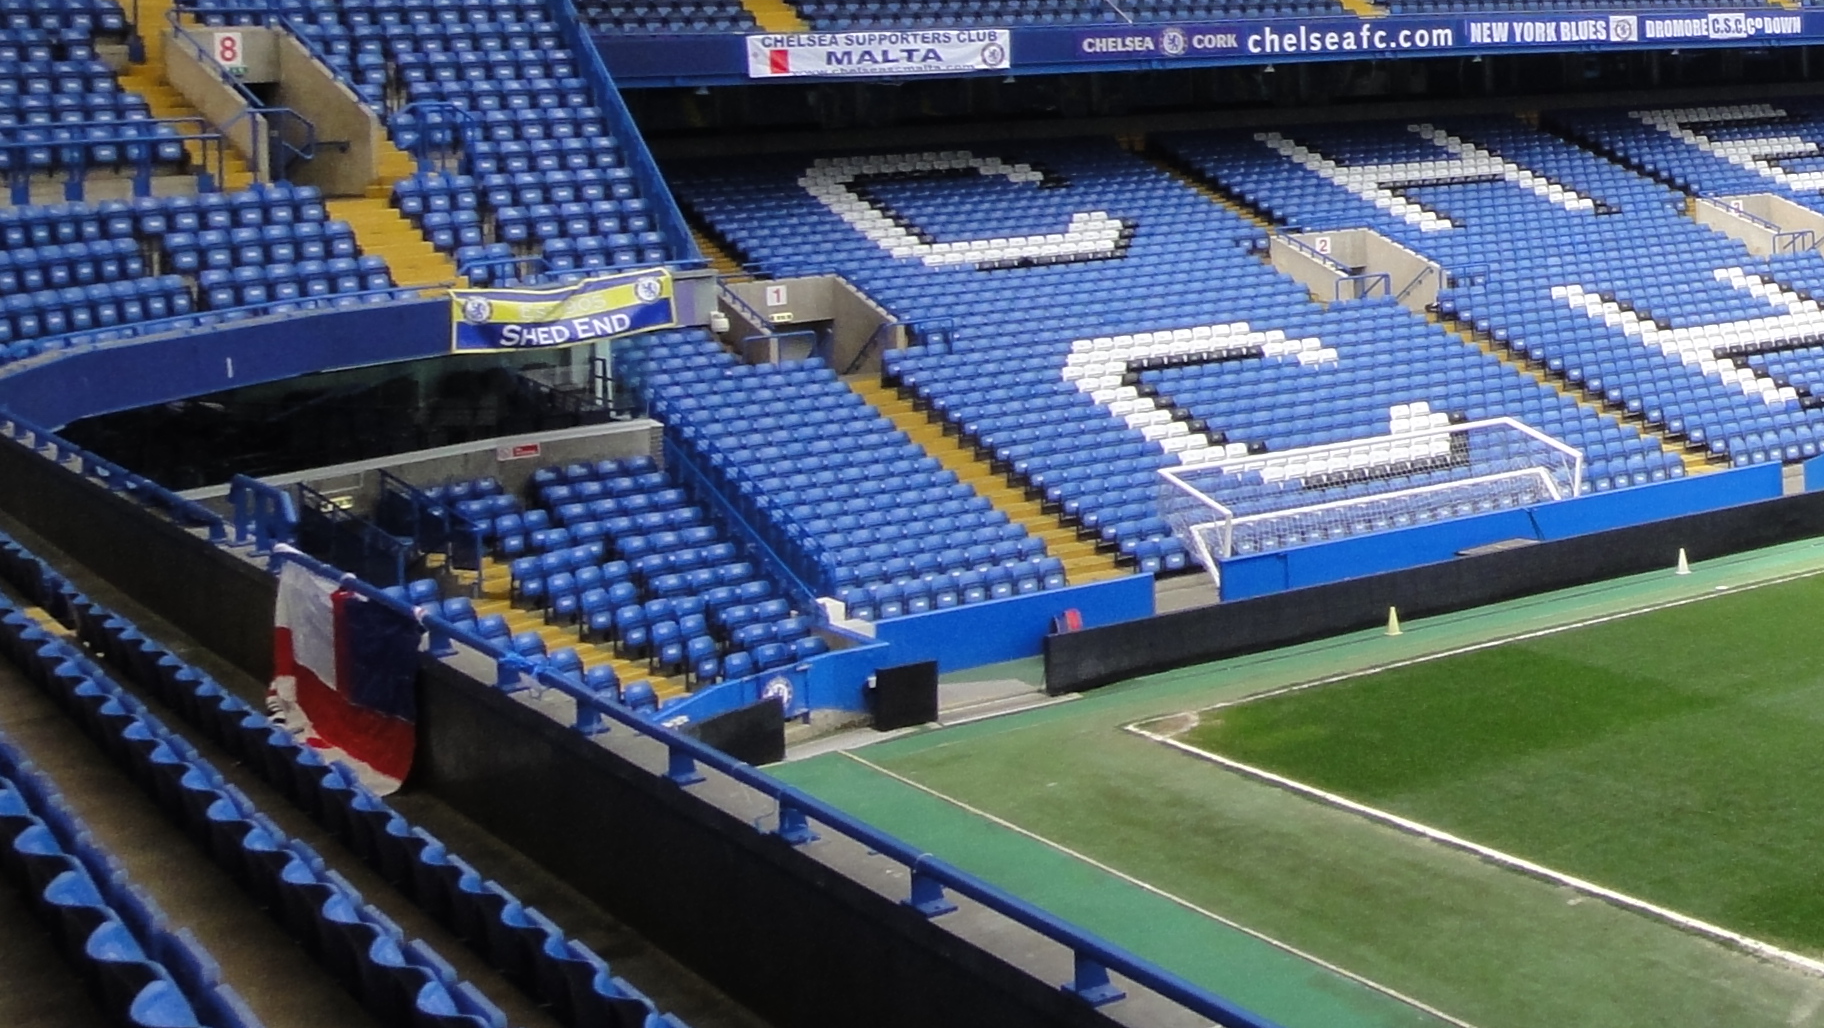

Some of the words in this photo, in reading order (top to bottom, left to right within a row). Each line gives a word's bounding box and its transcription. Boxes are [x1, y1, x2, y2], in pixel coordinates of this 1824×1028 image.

[1470, 22, 1509, 43] NEW
[1512, 21, 1557, 42] YORK
[1559, 20, 1607, 41] BLUES
[1645, 19, 1708, 38] DROMORE
[1712, 17, 1747, 34] C.S.C.
[1763, 16, 1801, 34] DOWN
[761, 33, 838, 48] CHELSEA
[844, 31, 951, 47] SUPPORTERS
[956, 29, 998, 43] CLUB
[1081, 36, 1155, 53] CHELSEA
[1192, 34, 1239, 49] CORK
[1247, 23, 1453, 53] chelseafc.com
[220, 36, 237, 62] 8
[825, 47, 945, 66] MALTA
[1319, 239, 1328, 252] 2
[772, 288, 781, 303] 1
[500, 324, 571, 347] SHED
[572, 314, 631, 339] END
